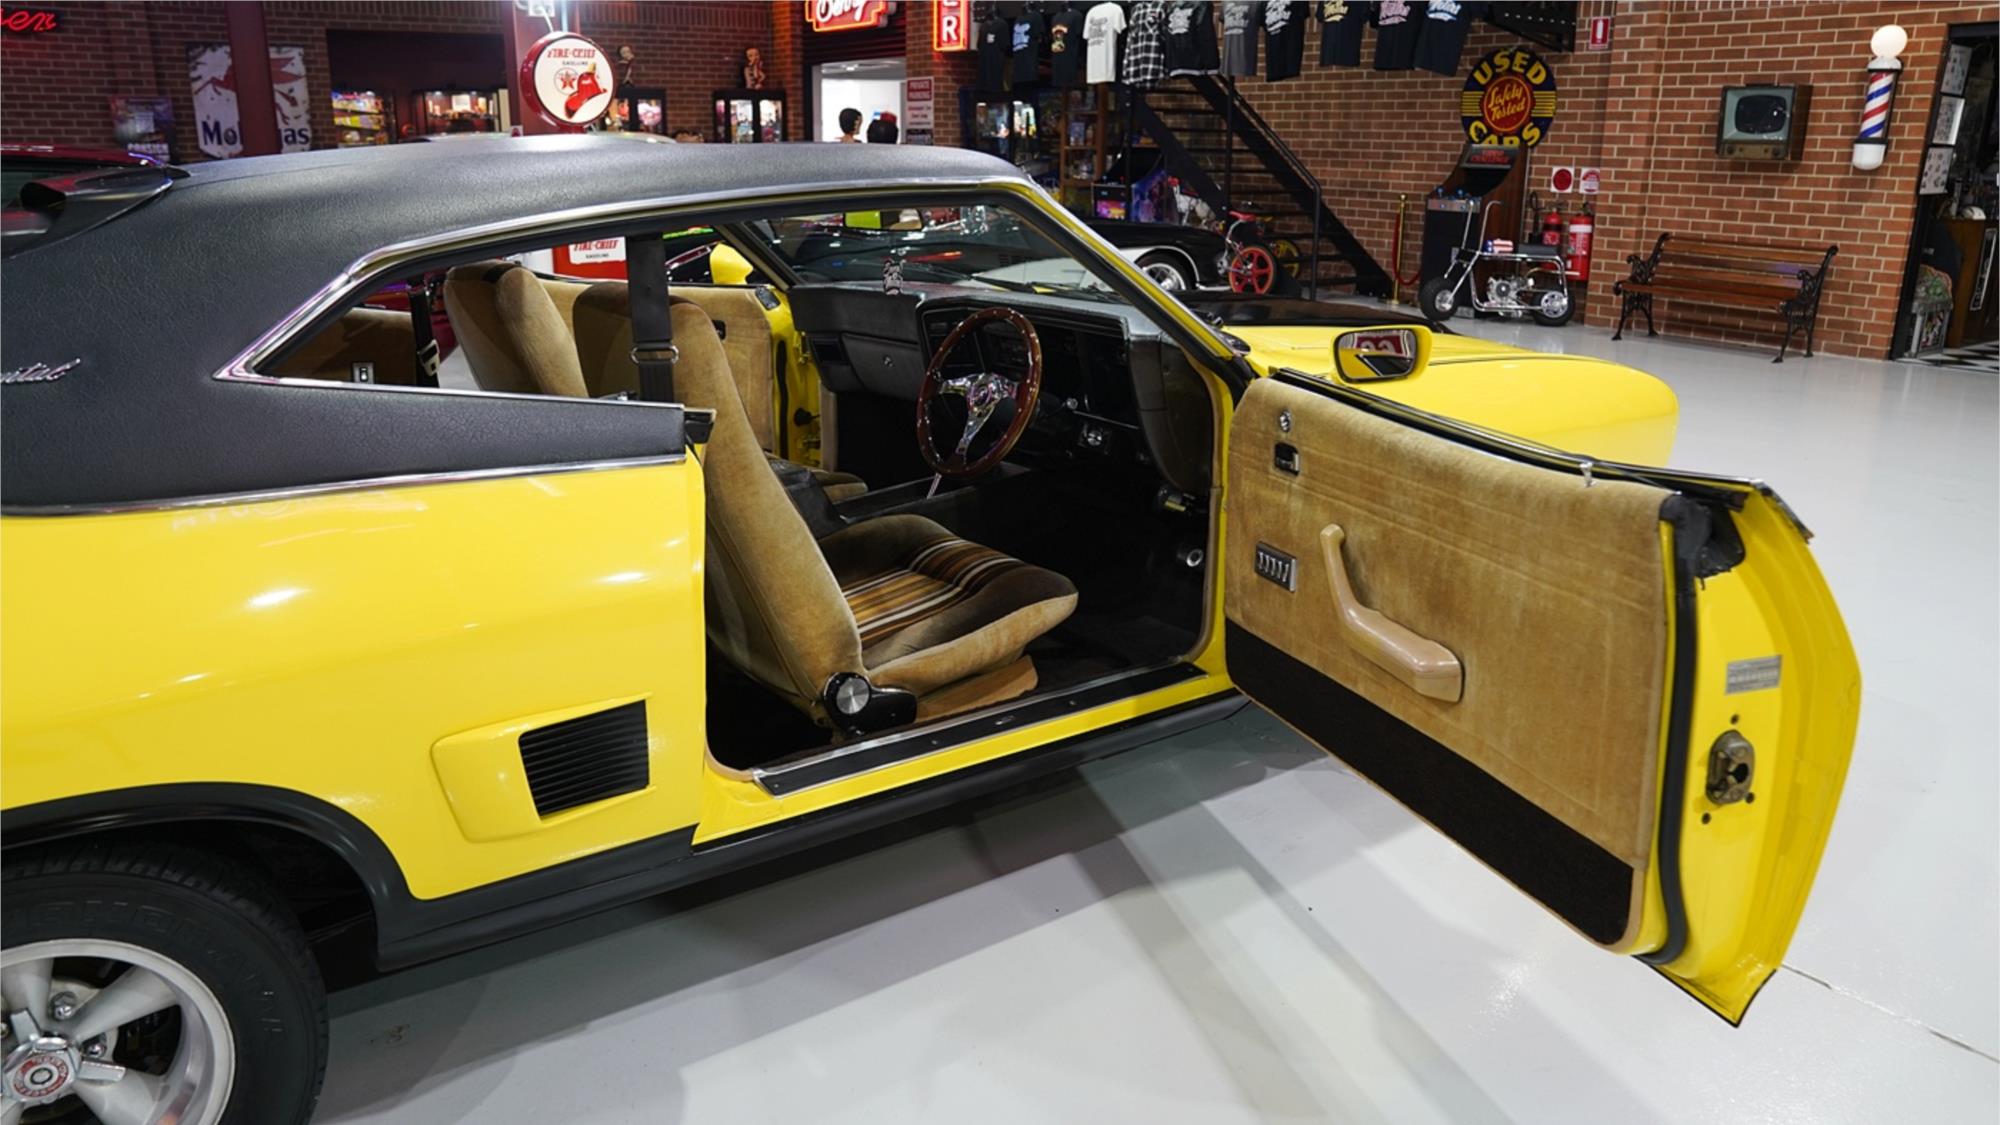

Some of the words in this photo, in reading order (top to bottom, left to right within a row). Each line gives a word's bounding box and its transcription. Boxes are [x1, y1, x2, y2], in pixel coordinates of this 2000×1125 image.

[1473, 51, 1547, 85] USED
[1488, 83, 1524, 108] Safety
[1490, 97, 1526, 121] Tested
